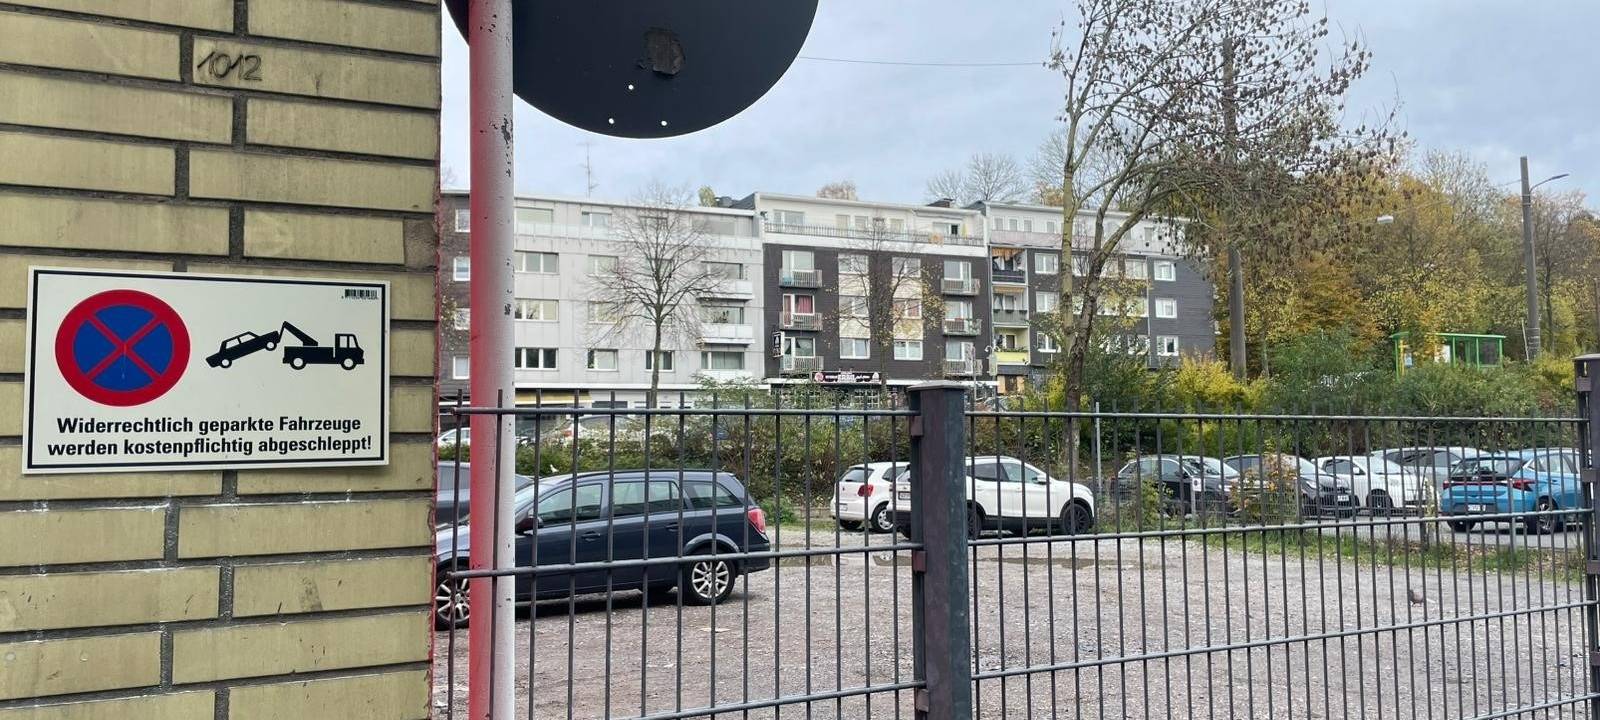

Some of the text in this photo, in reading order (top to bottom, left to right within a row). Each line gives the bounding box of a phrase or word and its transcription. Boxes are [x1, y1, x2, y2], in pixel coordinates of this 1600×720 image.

[197, 51, 262, 82] 1012
[57, 416, 361, 436] Widerrechtlich geparkte Fahrzeuge
[47, 436, 372, 458] werden kostenpflichtig abgeschleppt!
